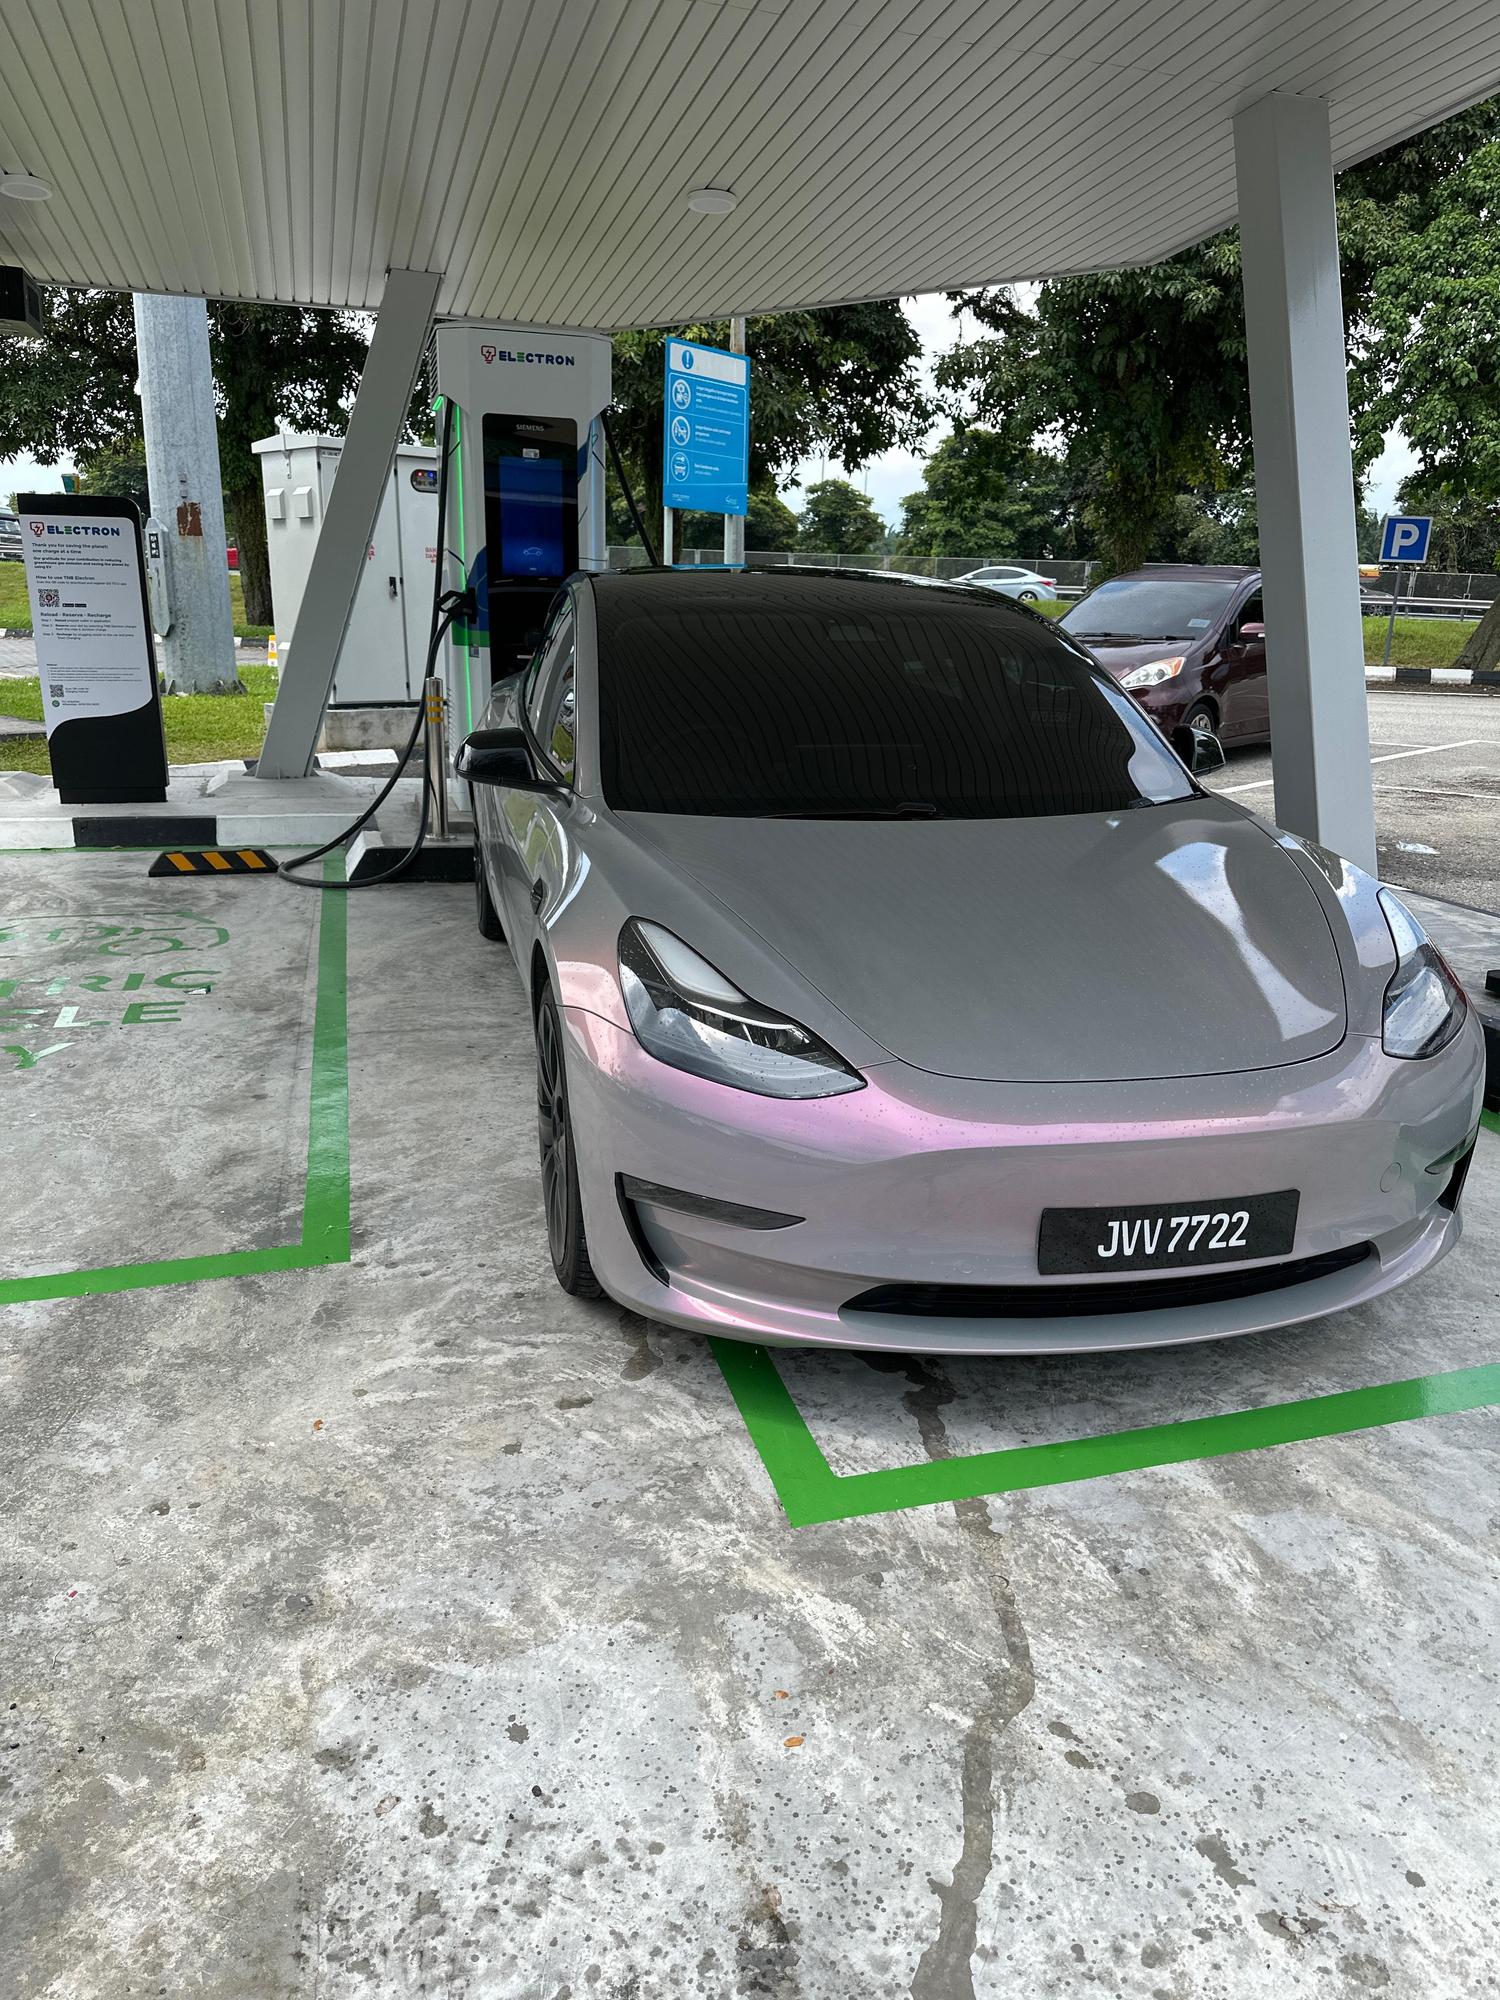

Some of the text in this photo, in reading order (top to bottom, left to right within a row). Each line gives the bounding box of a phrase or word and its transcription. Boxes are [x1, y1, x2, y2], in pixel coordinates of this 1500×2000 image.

[498, 351, 575, 366] ELECTRON
[516, 424, 544, 432] SIEMENS
[47, 526, 120, 536] ELECTRON
[1390, 523, 1420, 557] P
[1097, 1210, 1250, 1258] JVV 7722
